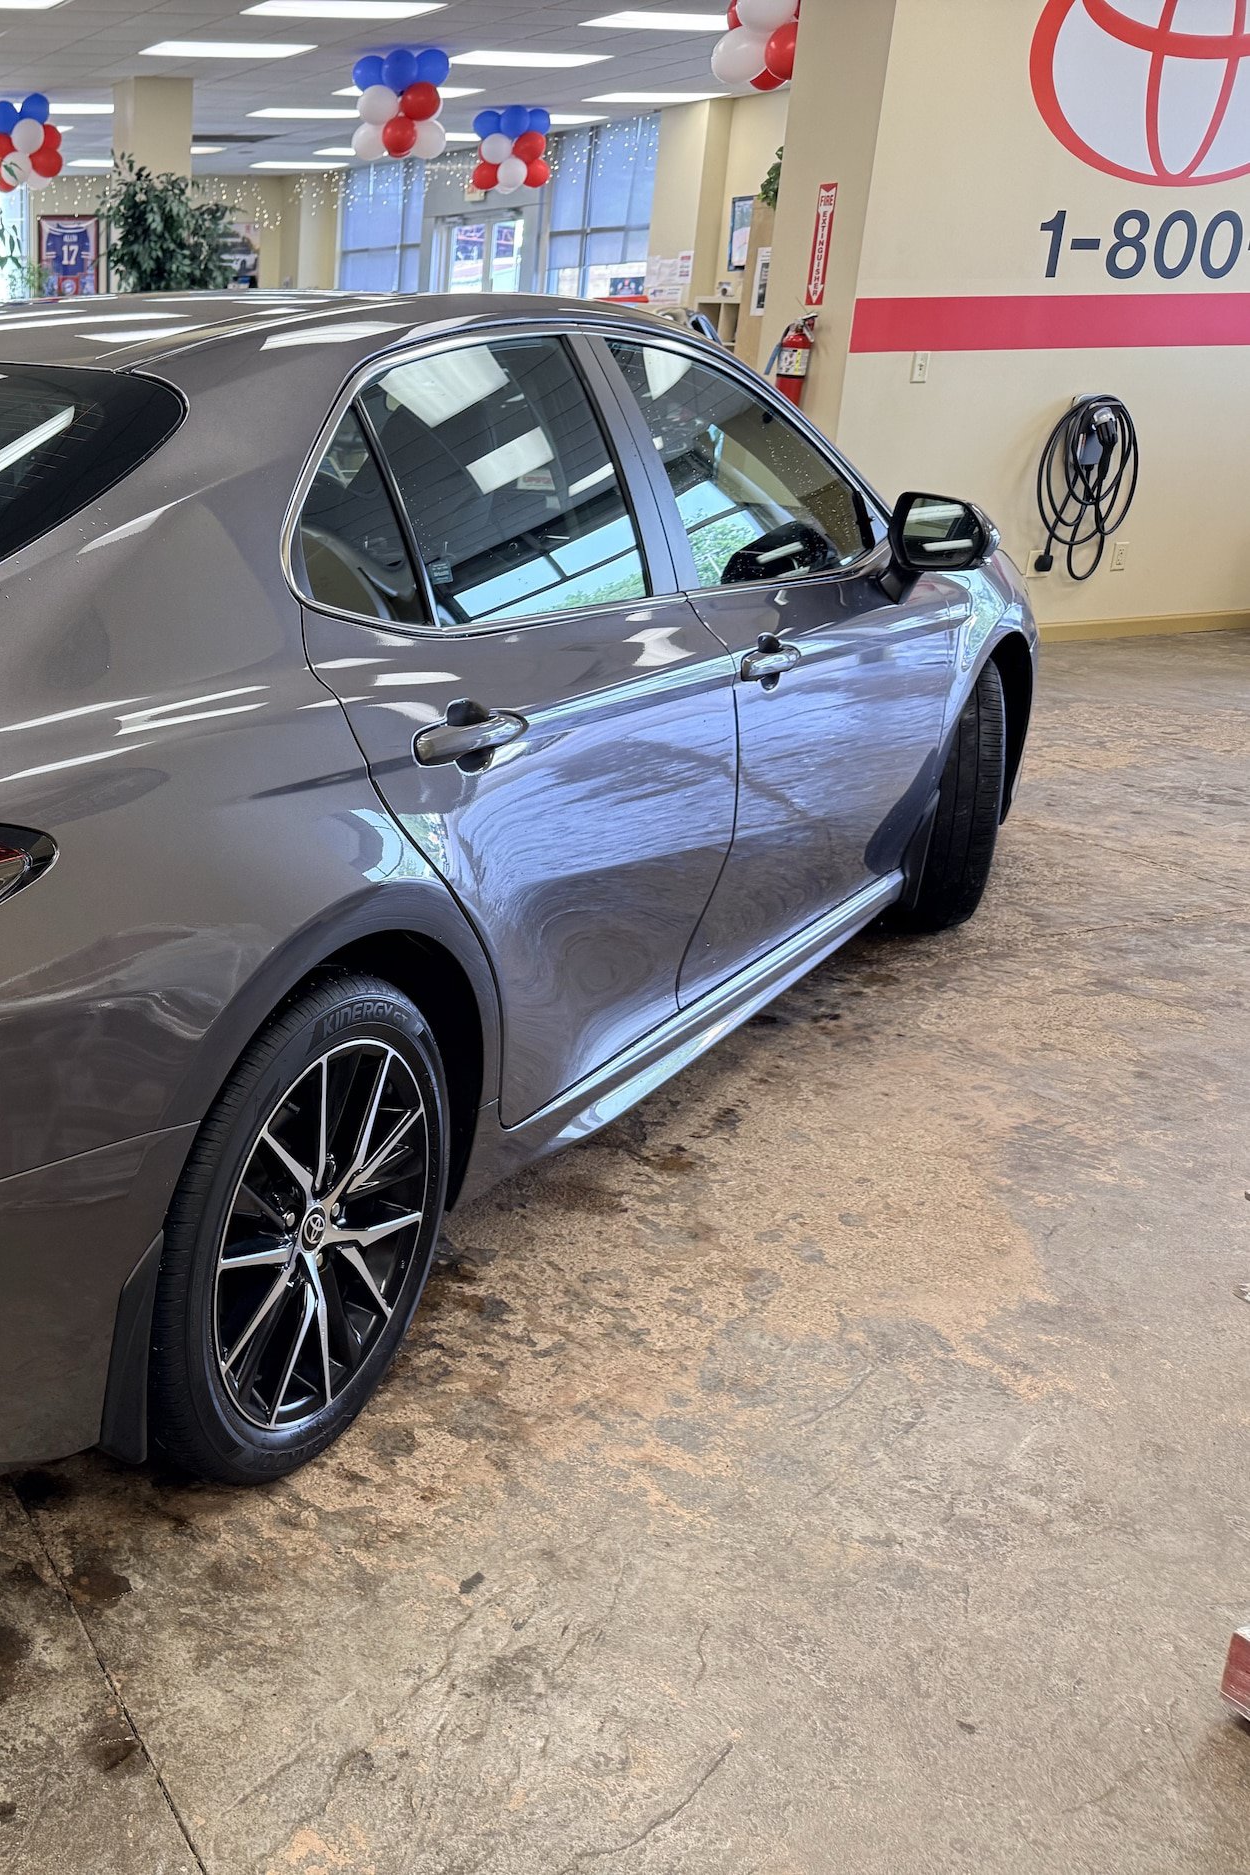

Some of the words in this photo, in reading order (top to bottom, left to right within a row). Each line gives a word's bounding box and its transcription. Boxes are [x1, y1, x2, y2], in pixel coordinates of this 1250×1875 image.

[820, 195, 834, 207] FIRE
[62, 245, 79, 265] 17
[812, 210, 828, 296] EXTINGUISHER
[1040, 209, 1250, 280] 1-800
[323, 1001, 394, 1038] KINERGY
